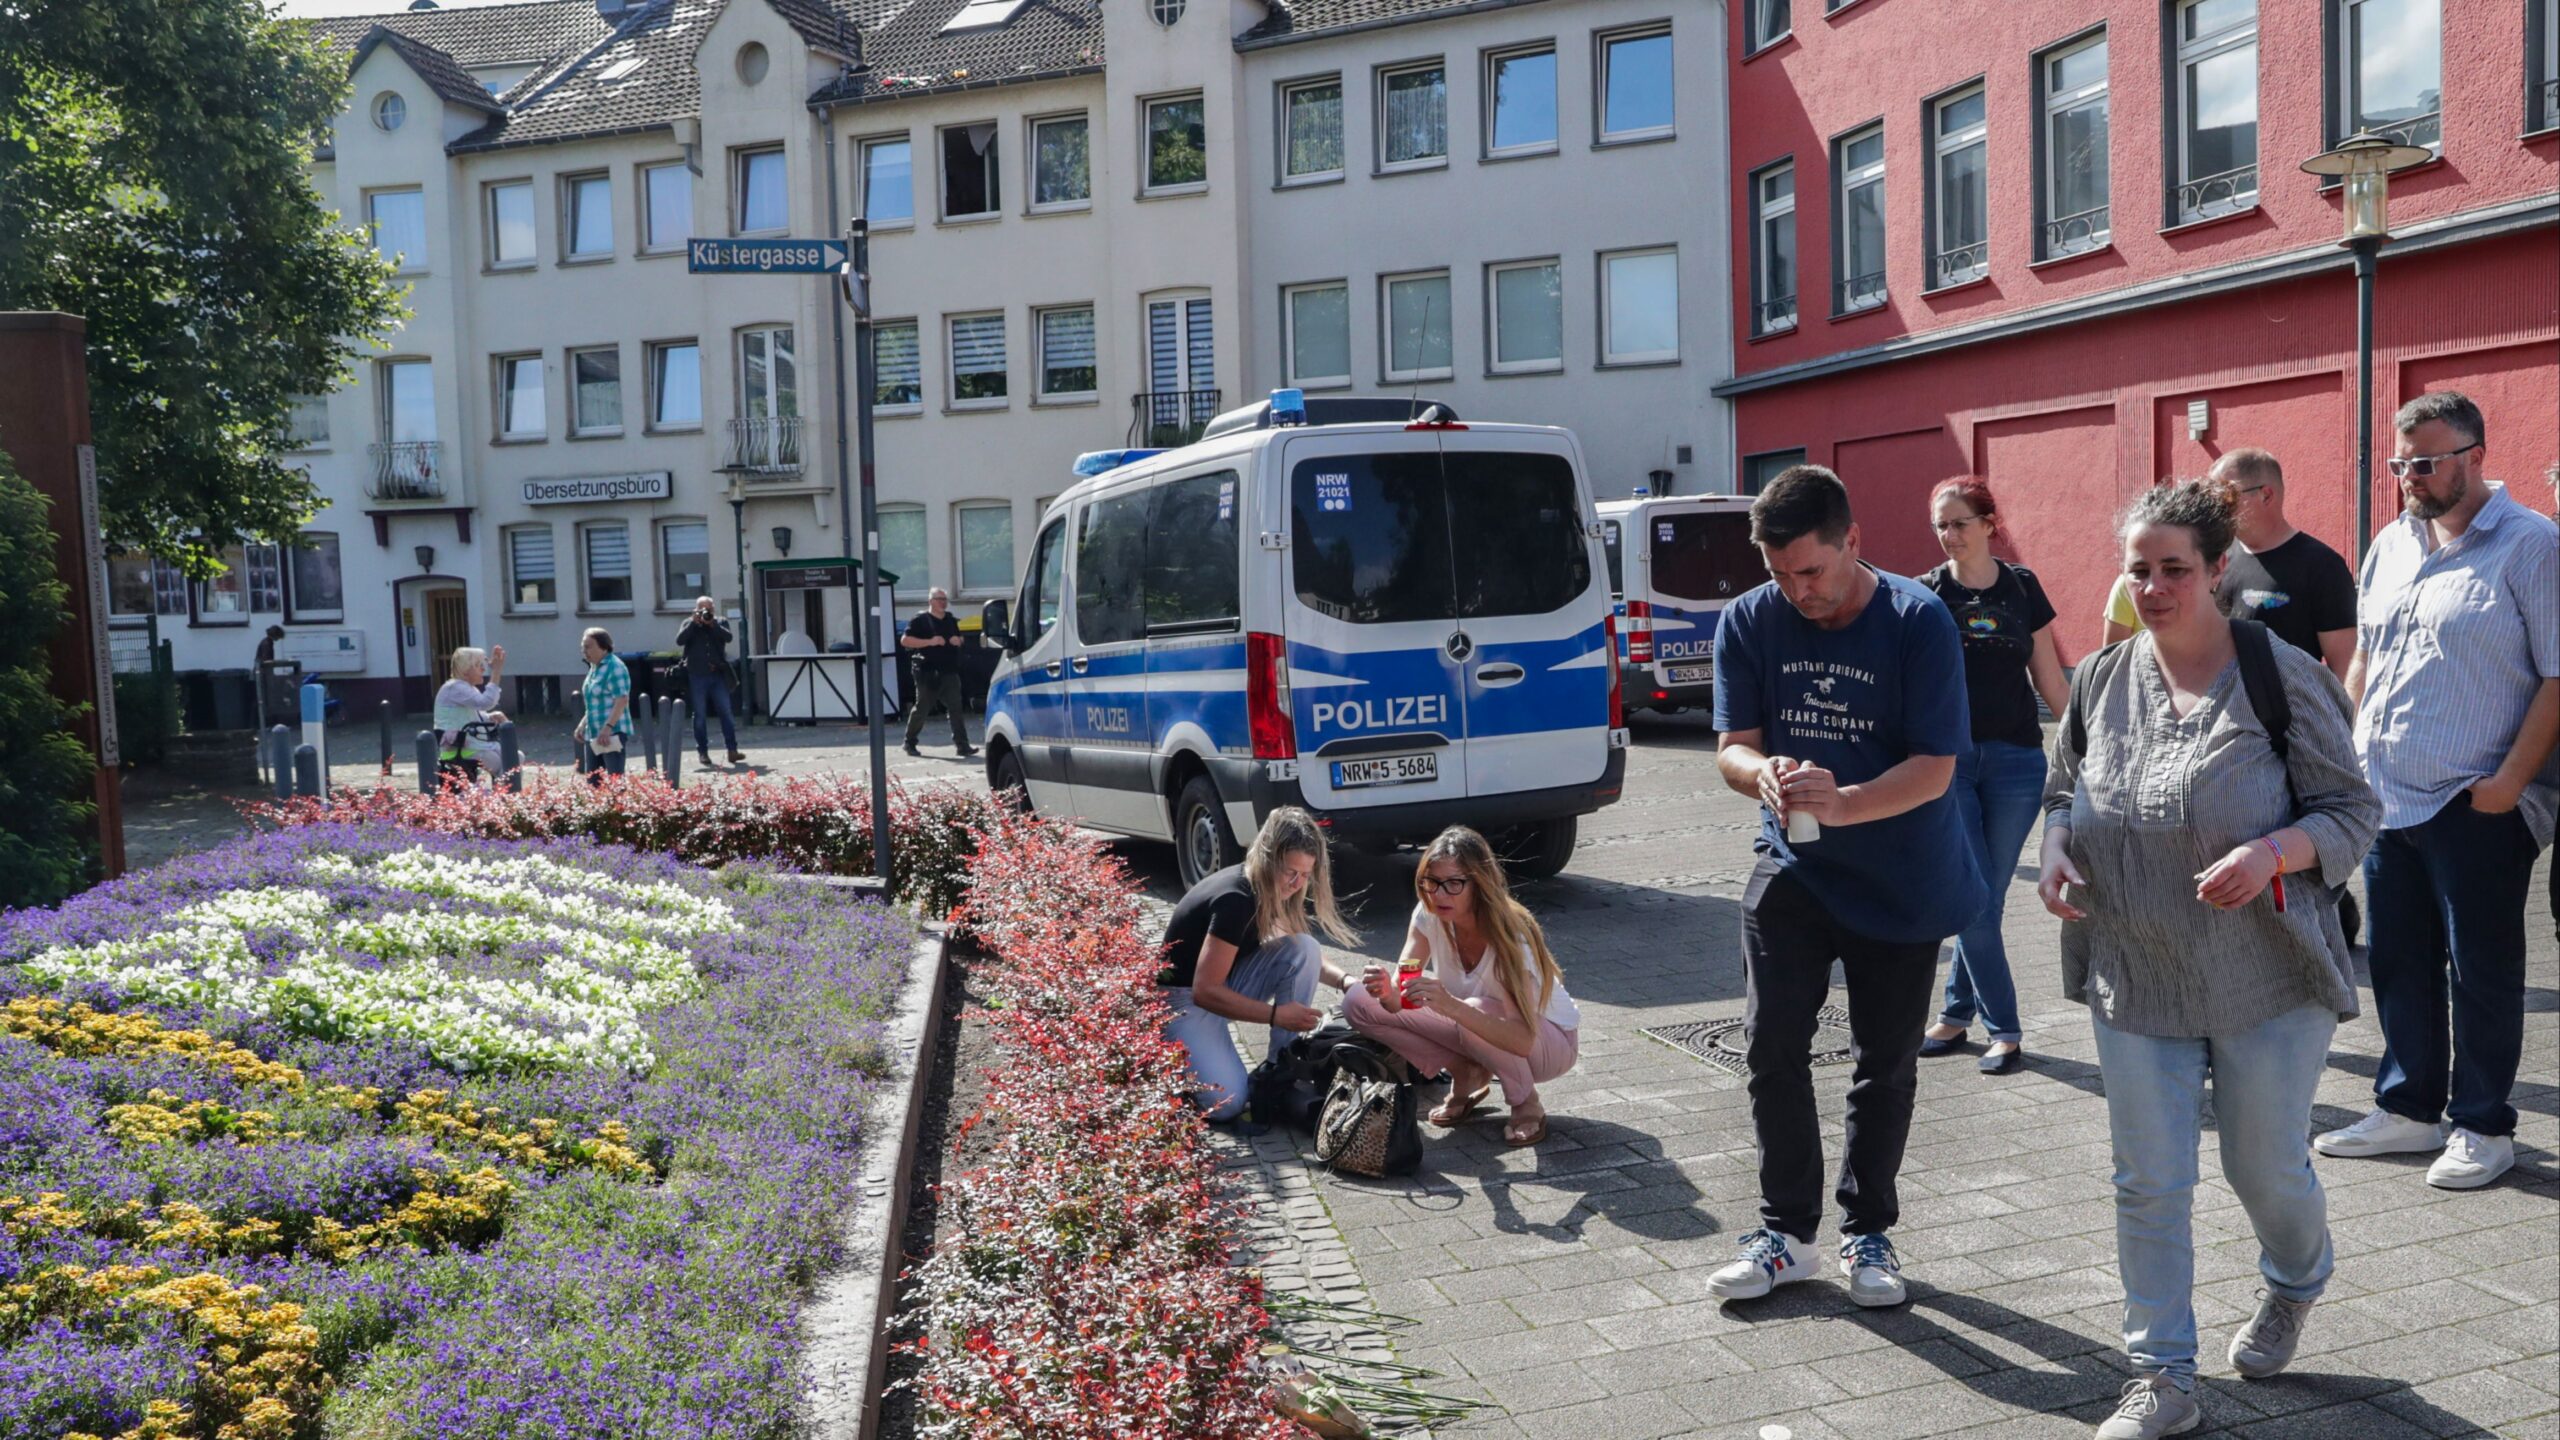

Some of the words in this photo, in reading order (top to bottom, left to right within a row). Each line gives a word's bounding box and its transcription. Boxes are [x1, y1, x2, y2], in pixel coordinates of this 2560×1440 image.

[694, 243, 819, 270] Küstergasse
[524, 476, 661, 500] Übersetzungsbüro
[1316, 473, 1348, 486] NRW
[1318, 486, 1350, 498] 21021
[1662, 640, 1714, 657] POLIZE
[1828, 663, 1875, 685] ORIGINAL
[1087, 707, 1130, 733] POLIZEI
[1312, 694, 1447, 732] POLIZEI
[1780, 708, 1819, 723] JEANS
[1790, 727, 1844, 740] ESTABLISHED
[1341, 762, 1372, 782] NRW
[1380, 756, 1434, 779] 5-5684
